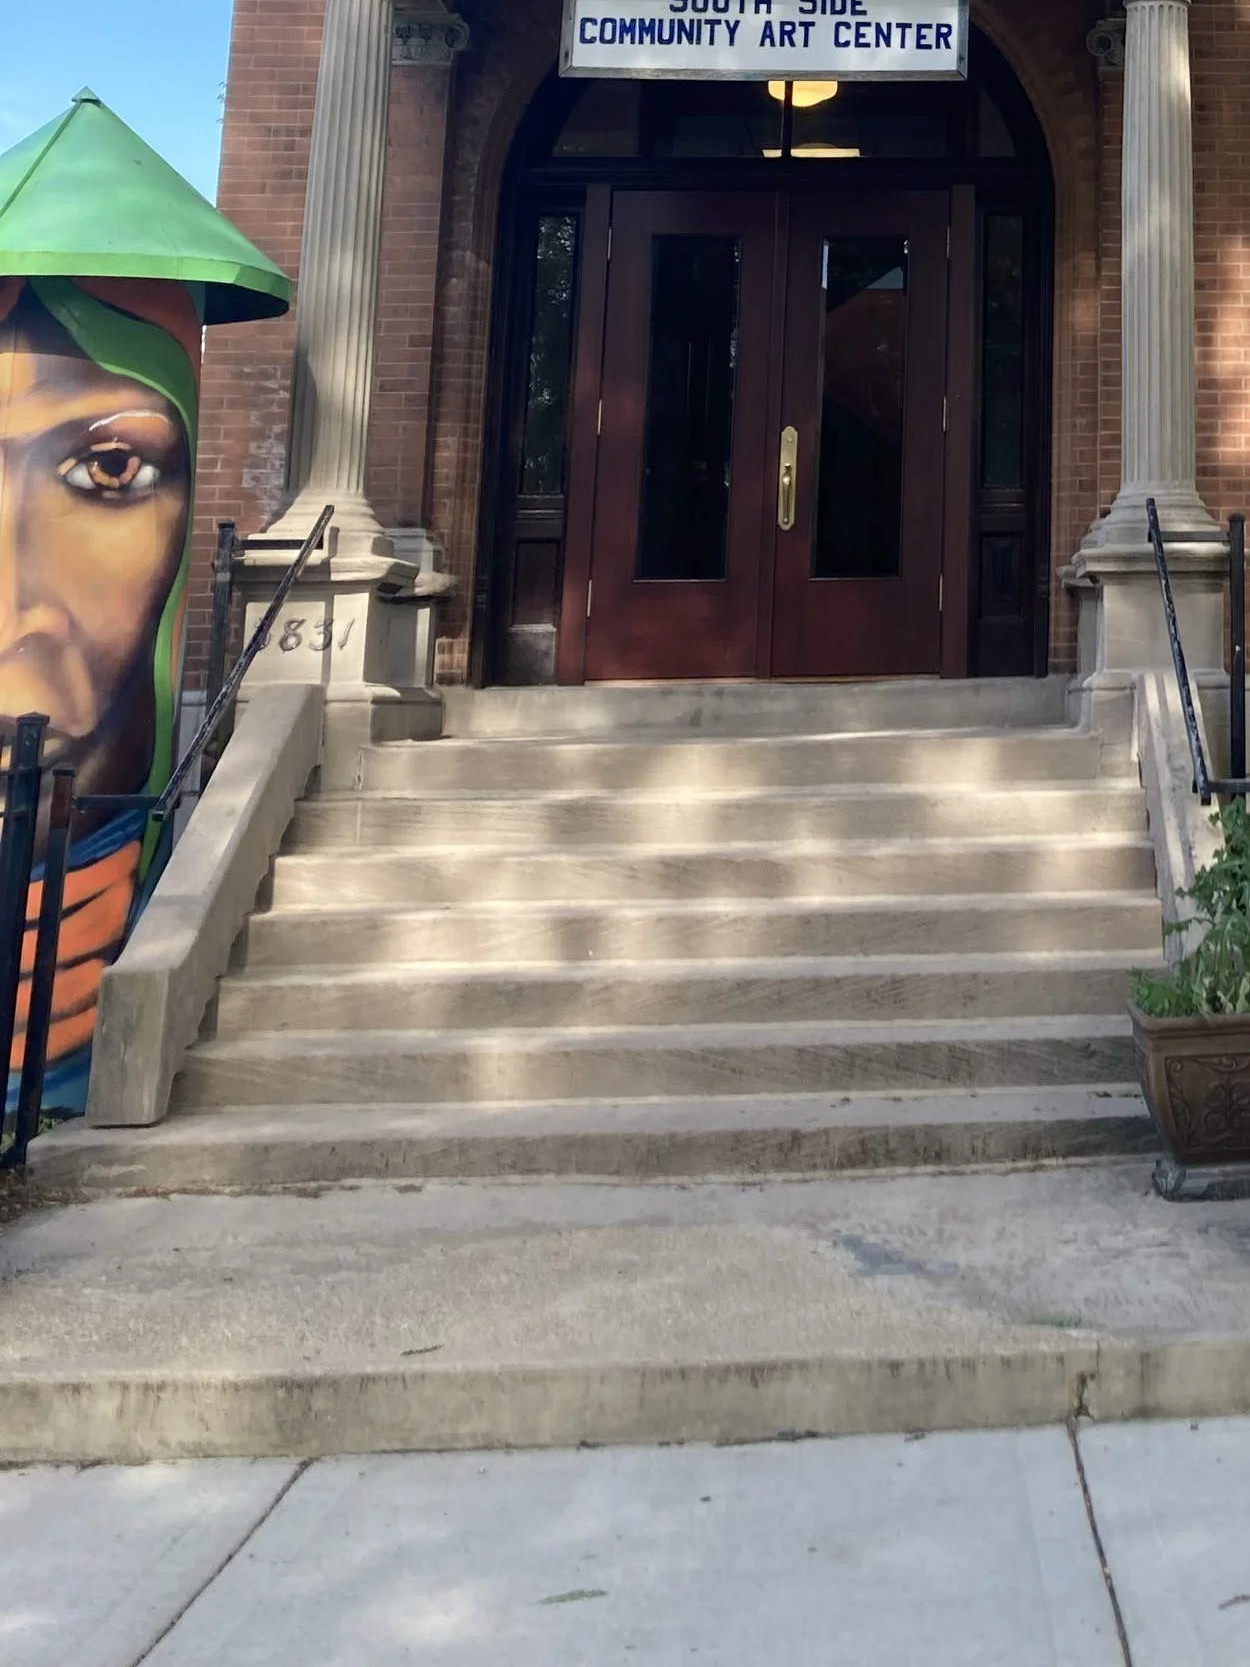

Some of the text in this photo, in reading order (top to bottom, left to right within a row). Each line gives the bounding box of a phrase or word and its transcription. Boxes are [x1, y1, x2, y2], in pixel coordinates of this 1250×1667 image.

[579, 17, 953, 50] COMMUNITY ART CENTER
